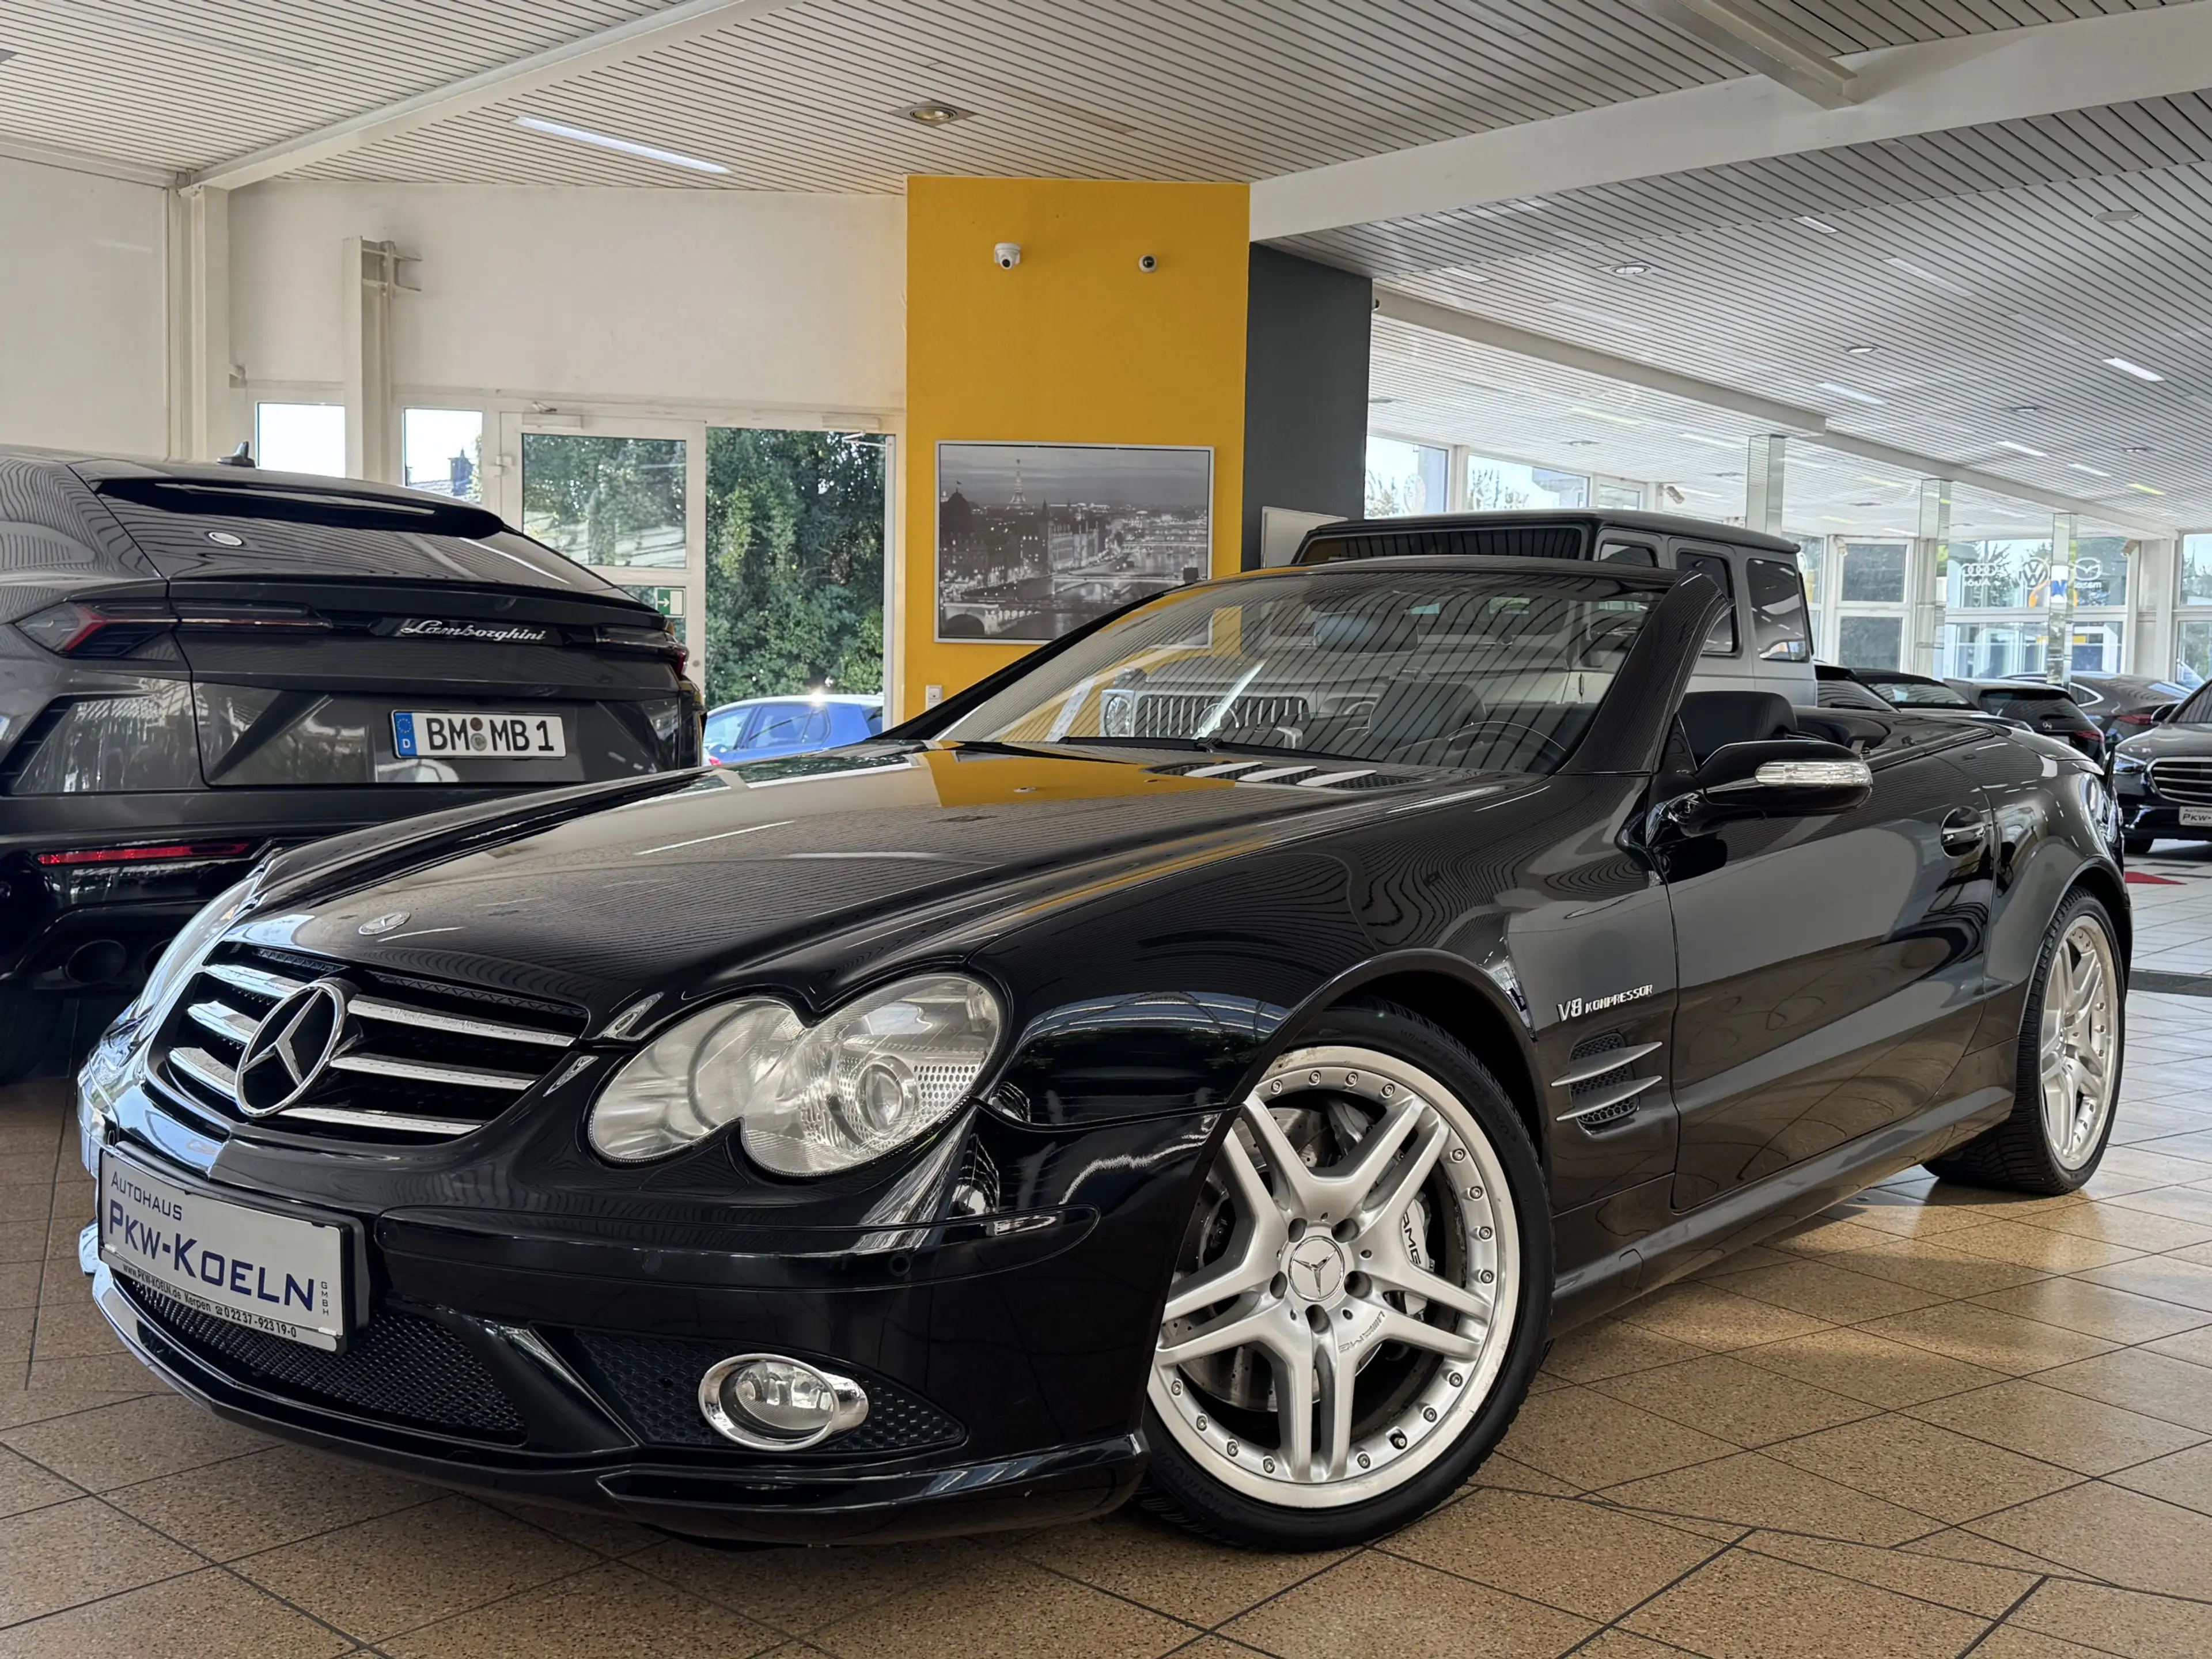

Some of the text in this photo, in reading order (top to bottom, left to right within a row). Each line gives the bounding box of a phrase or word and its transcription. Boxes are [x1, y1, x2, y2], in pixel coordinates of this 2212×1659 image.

[400, 620, 546, 641] Lamborghini
[403, 738, 410, 748] D
[426, 718, 555, 751] BM MB 1
[1556, 984, 1653, 1022] V8 KOMPRESSOR
[111, 1171, 182, 1221] AUTOHAUS
[1402, 1211, 1422, 1265] AMG
[184, 1293, 211, 1312] Kerpen
